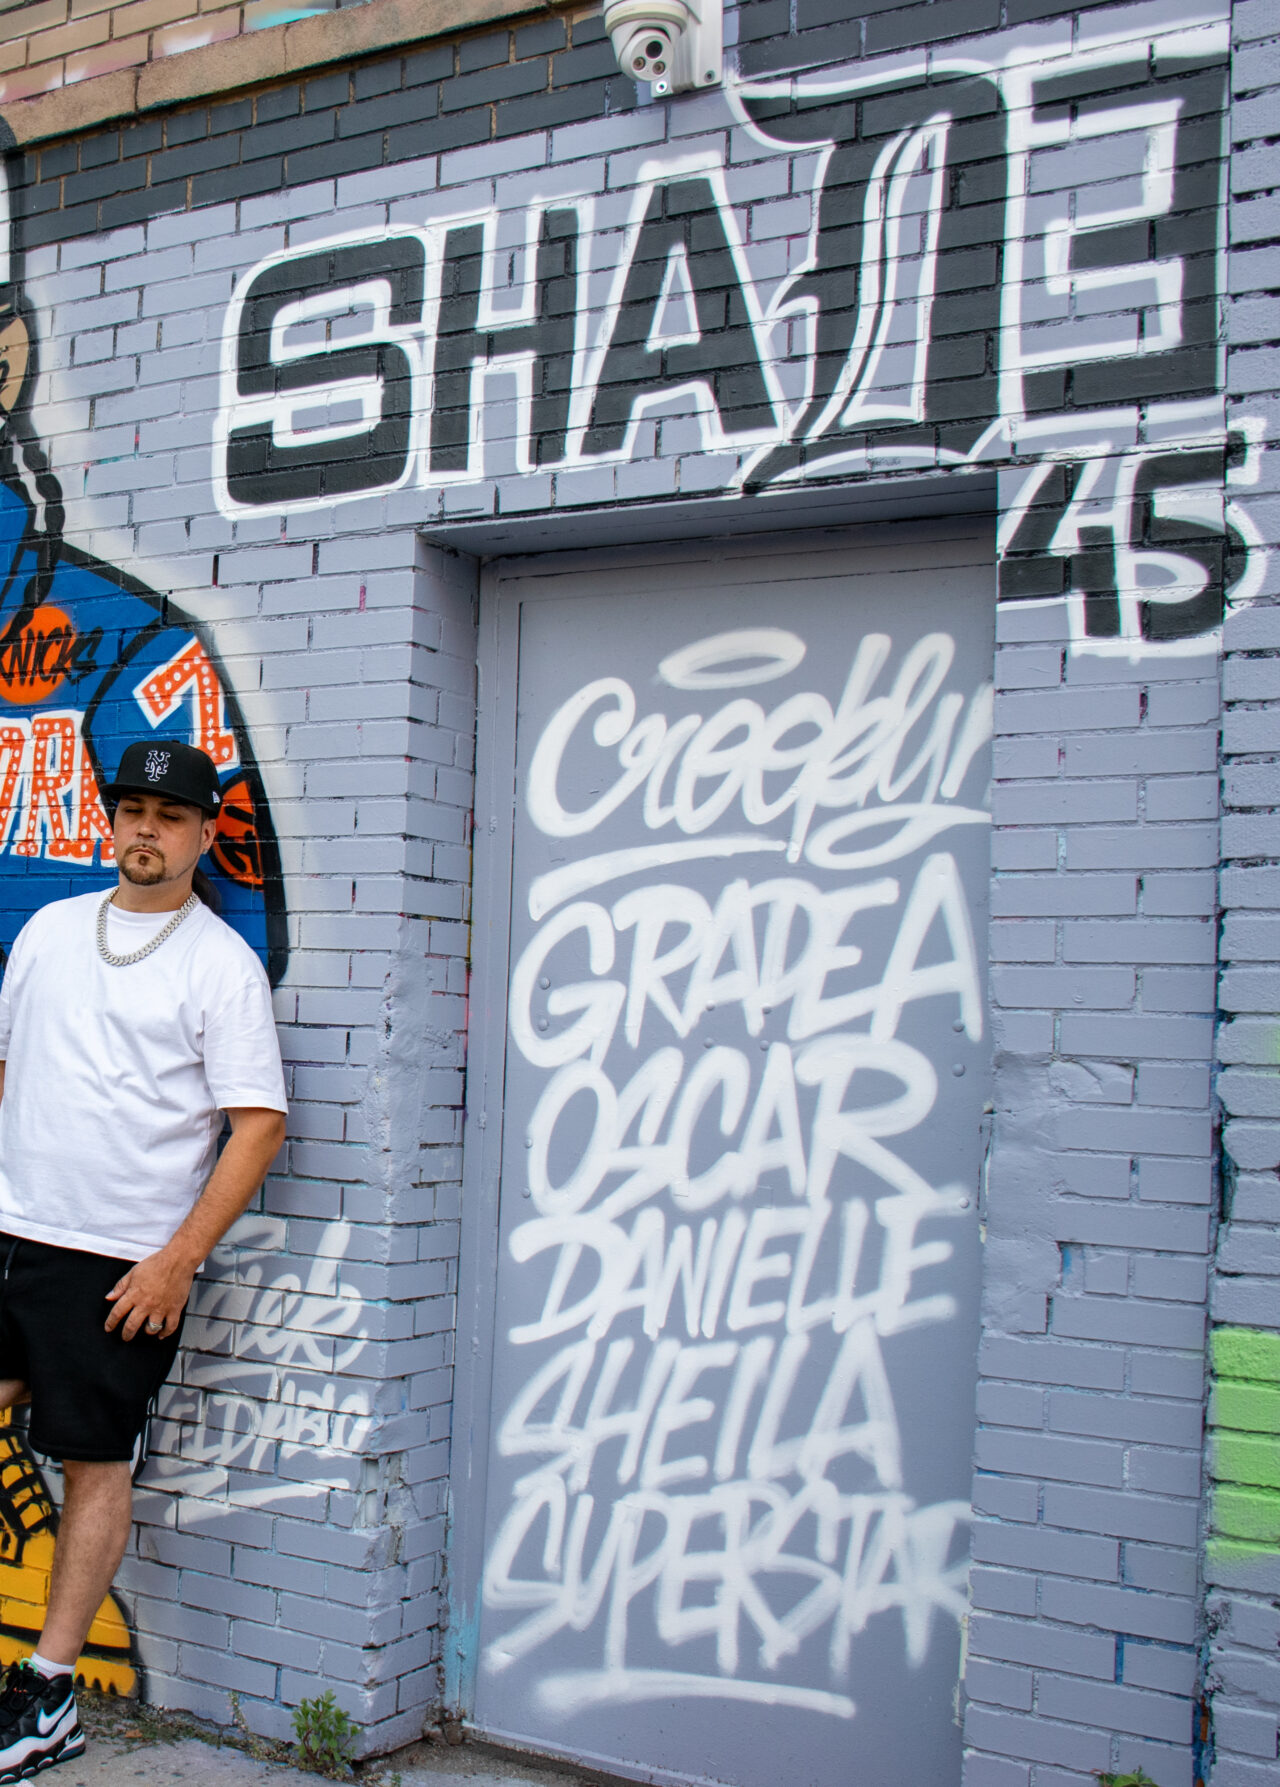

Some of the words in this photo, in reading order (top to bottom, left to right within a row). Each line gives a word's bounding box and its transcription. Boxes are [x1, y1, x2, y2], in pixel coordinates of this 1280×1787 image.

[995, 415, 1268, 662] 45
[528, 1033, 971, 1217] OSCAR
[509, 1197, 957, 1346] DANIELLE
[496, 1318, 902, 1496] SHEILA
